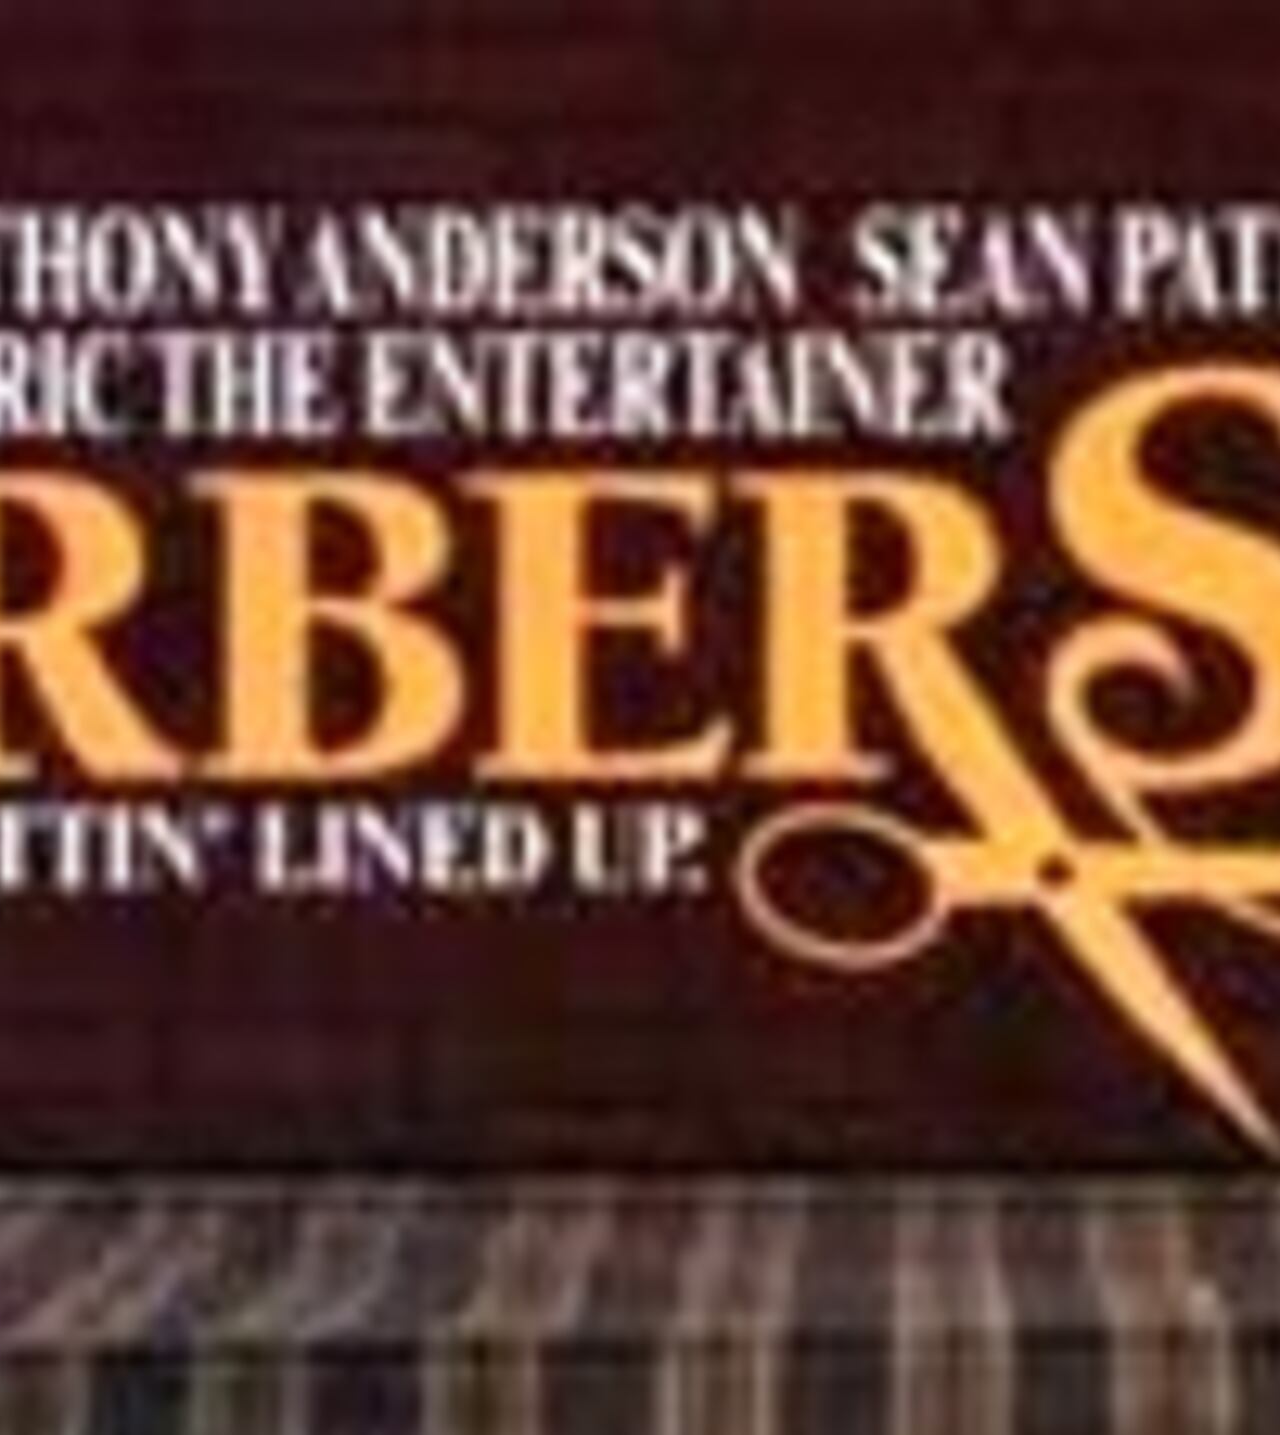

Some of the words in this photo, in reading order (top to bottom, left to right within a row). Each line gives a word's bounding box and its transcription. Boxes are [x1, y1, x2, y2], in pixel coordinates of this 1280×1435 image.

[304, 205, 801, 318] ANDERSON
[851, 207, 1093, 317] SEAN
[145, 328, 339, 439] THE
[363, 328, 1010, 439] ENTERTAINER
[255, 802, 553, 891] LINED
[571, 803, 706, 889] UP.
